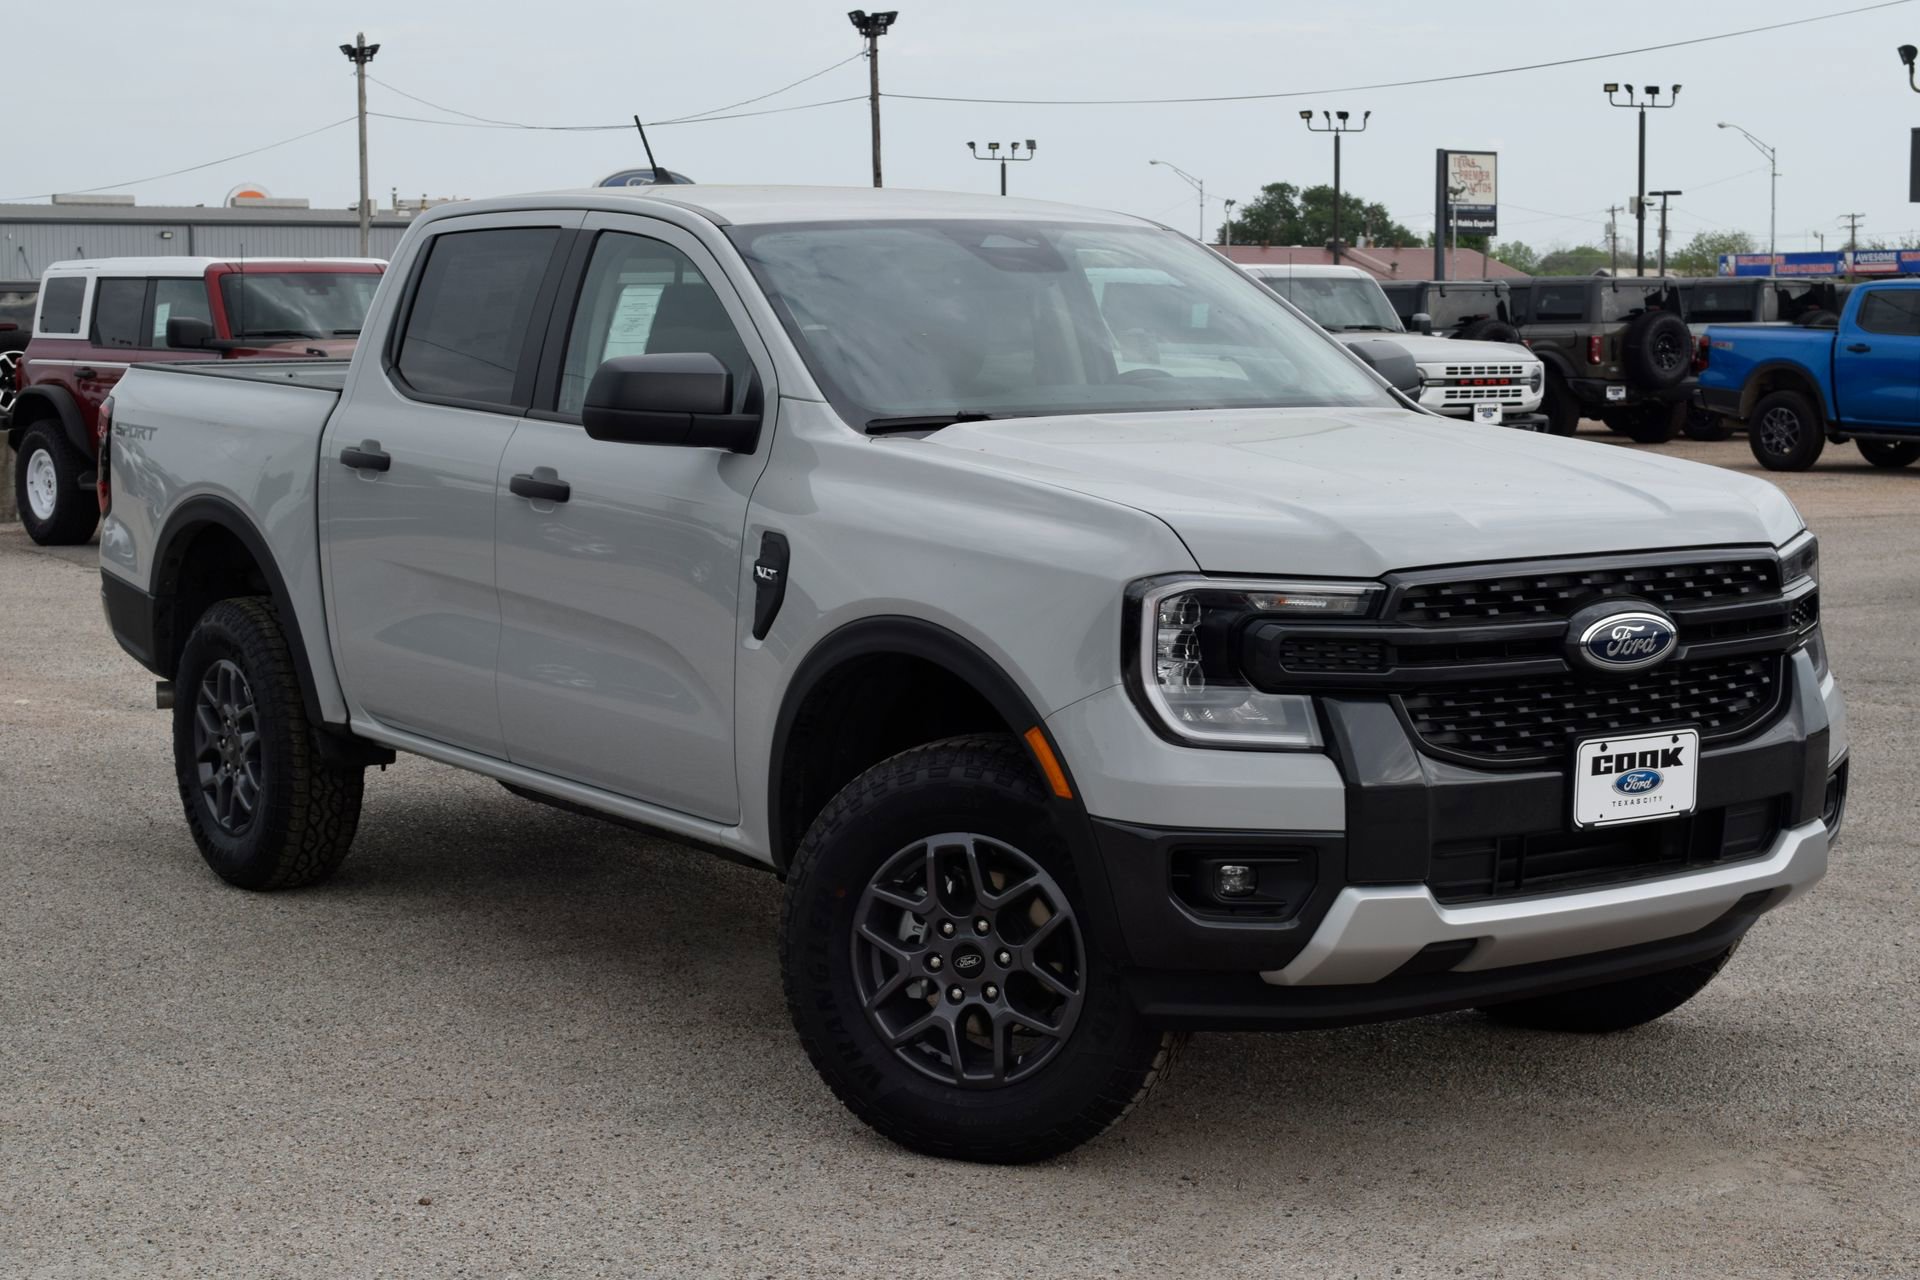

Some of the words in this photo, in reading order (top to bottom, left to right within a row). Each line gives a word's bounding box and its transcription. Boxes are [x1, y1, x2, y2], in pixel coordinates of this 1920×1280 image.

[1459, 170, 1490, 181] PREMIER
[1855, 252, 1897, 262] AWESOME
[115, 421, 159, 441] SPORT
[756, 565, 778, 580] XLT
[1606, 625, 1658, 657] Ford
[1591, 746, 1684, 776] COOK
[1623, 773, 1653, 791] Ford
[959, 956, 977, 967] Ford
